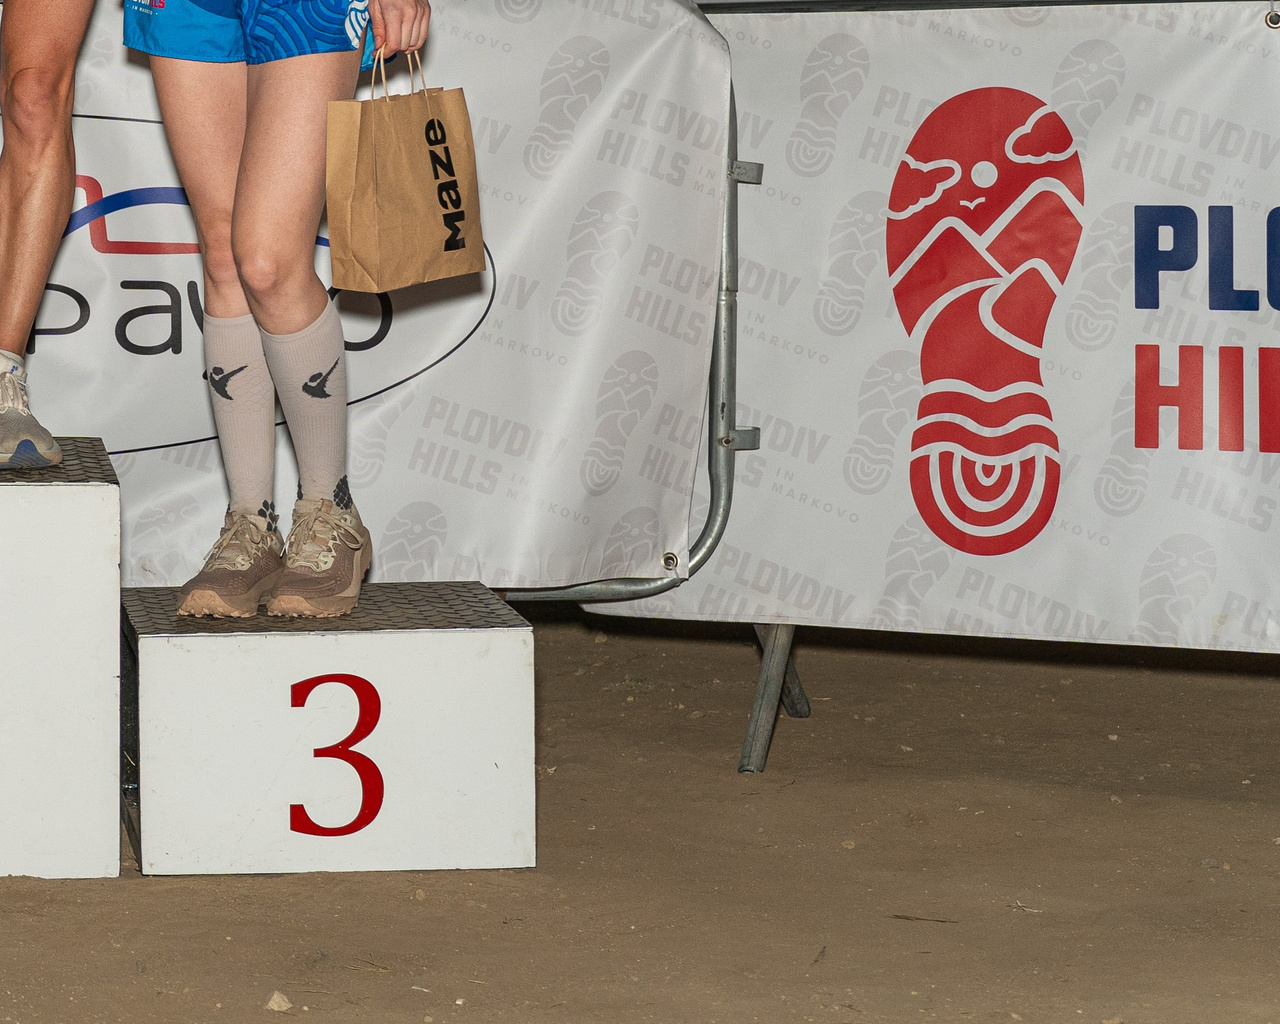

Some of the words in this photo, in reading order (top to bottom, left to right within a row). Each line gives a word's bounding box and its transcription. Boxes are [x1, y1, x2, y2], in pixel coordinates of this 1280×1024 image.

[928, 20, 1022, 57] MARKOVO
[596, 128, 690, 187] HILLS
[1125, 92, 1280, 170] PLOVDIV
[698, 166, 716, 180] IN
[1111, 136, 1216, 197] HILLS
[1225, 176, 1245, 189] IN
[1133, 204, 1280, 311] PL
[625, 285, 707, 346] HILLS
[747, 310, 765, 324] IN
[480, 329, 568, 366] MARKOVO
[741, 326, 830, 365] MARKOVO
[407, 437, 503, 496] HILLS
[776, 467, 795, 482] IN
[771, 482, 860, 523] MARKOVO
[1171, 466, 1277, 532] HILLS
[713, 542, 857, 624] PLOVDIV
[956, 566, 1109, 640] PLOVDIV
[290, 673, 384, 837] 3
